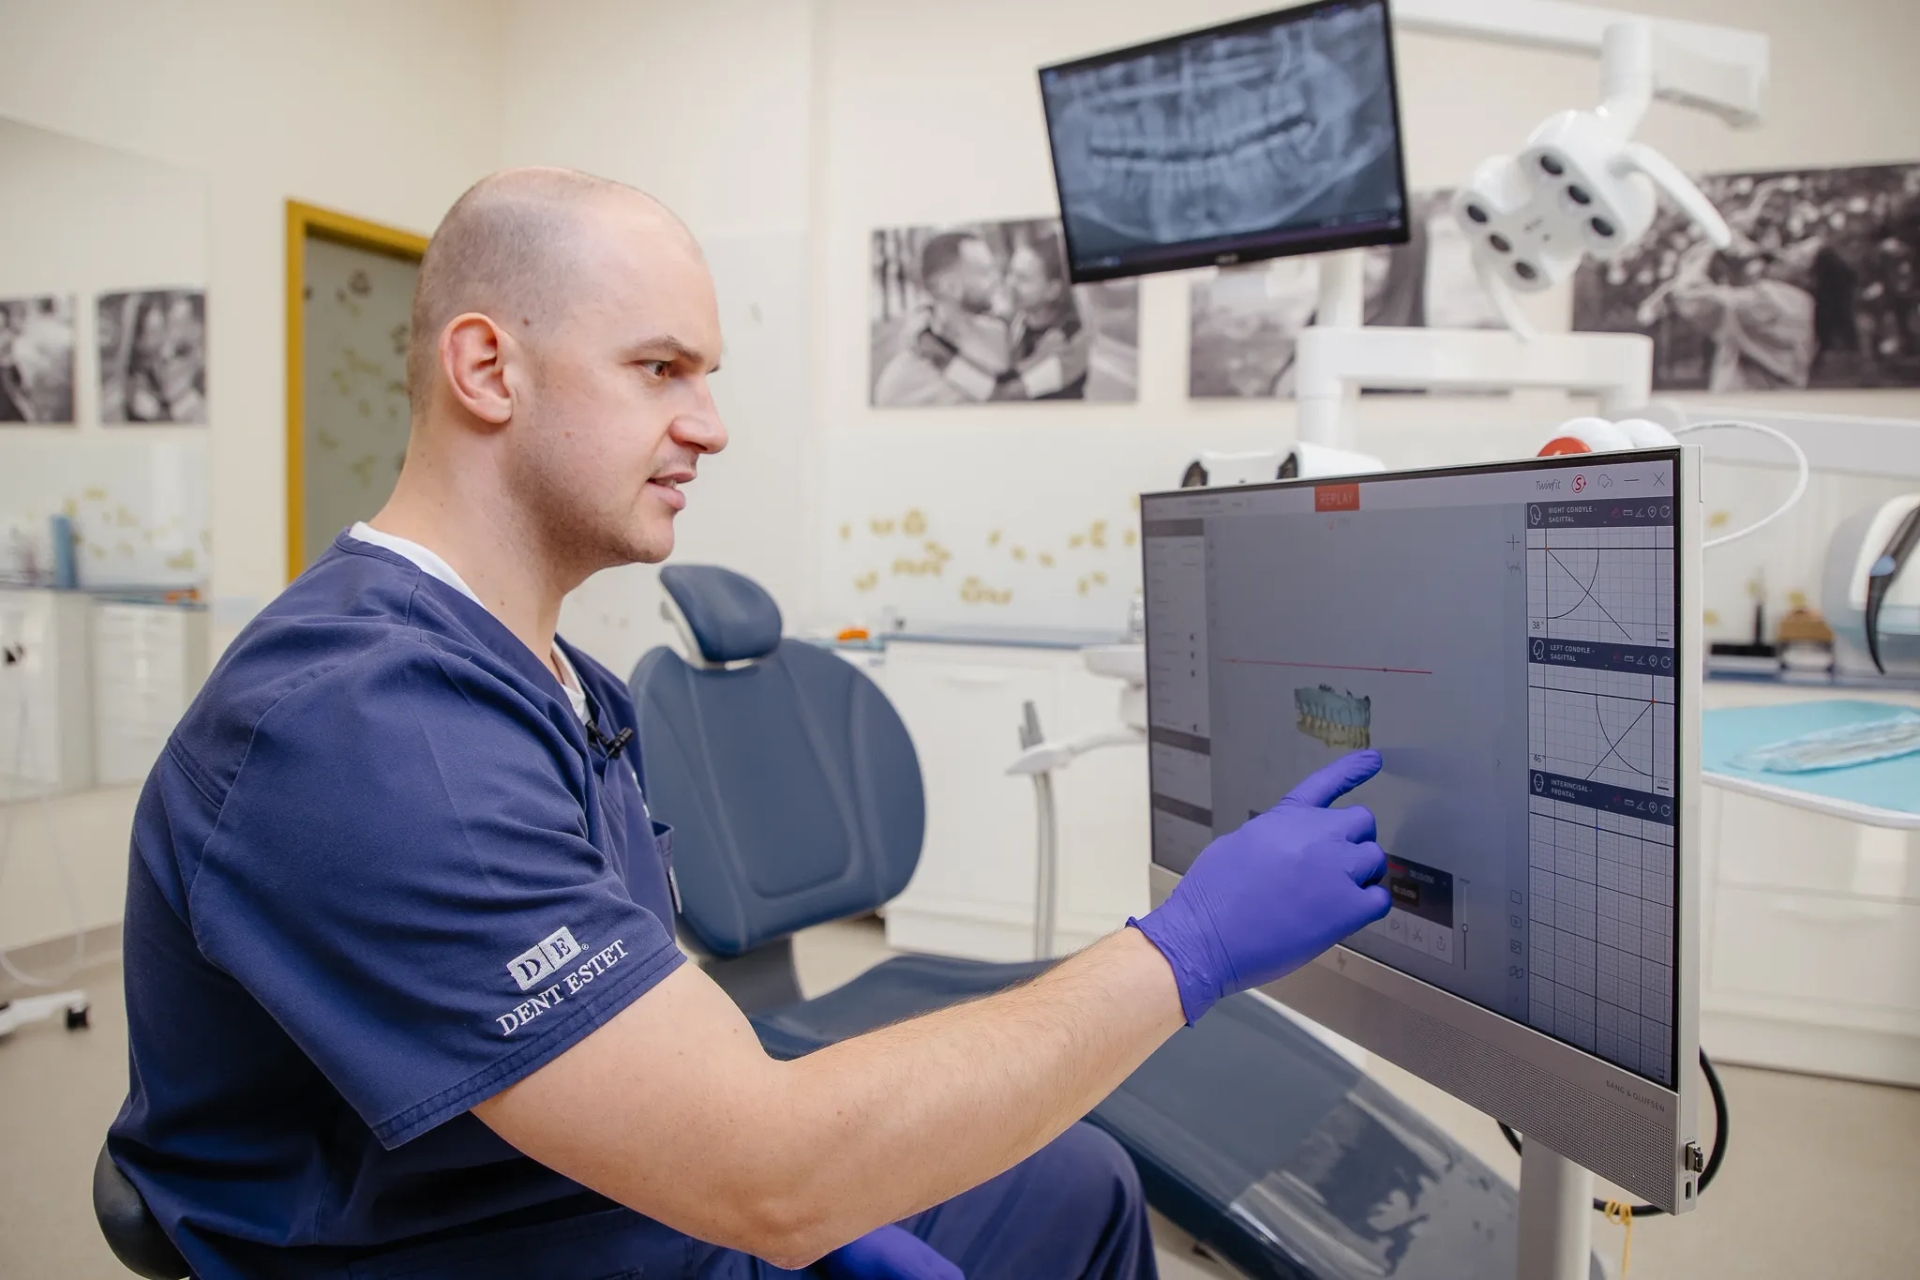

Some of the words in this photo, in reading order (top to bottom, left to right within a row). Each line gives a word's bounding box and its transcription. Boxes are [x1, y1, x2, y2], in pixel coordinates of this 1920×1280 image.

[1319, 491, 1354, 506] REPLAY
[1566, 505, 1592, 513] CONDYLE
[1564, 645, 1591, 653] CONDYLE
[1550, 653, 1576, 662] SAGITTAL
[1551, 788, 1576, 798] FRONTAL
[495, 984, 564, 1036] DENT
[562, 939, 629, 995] ESTET
[1633, 1092, 1665, 1112] OLUFSEN
